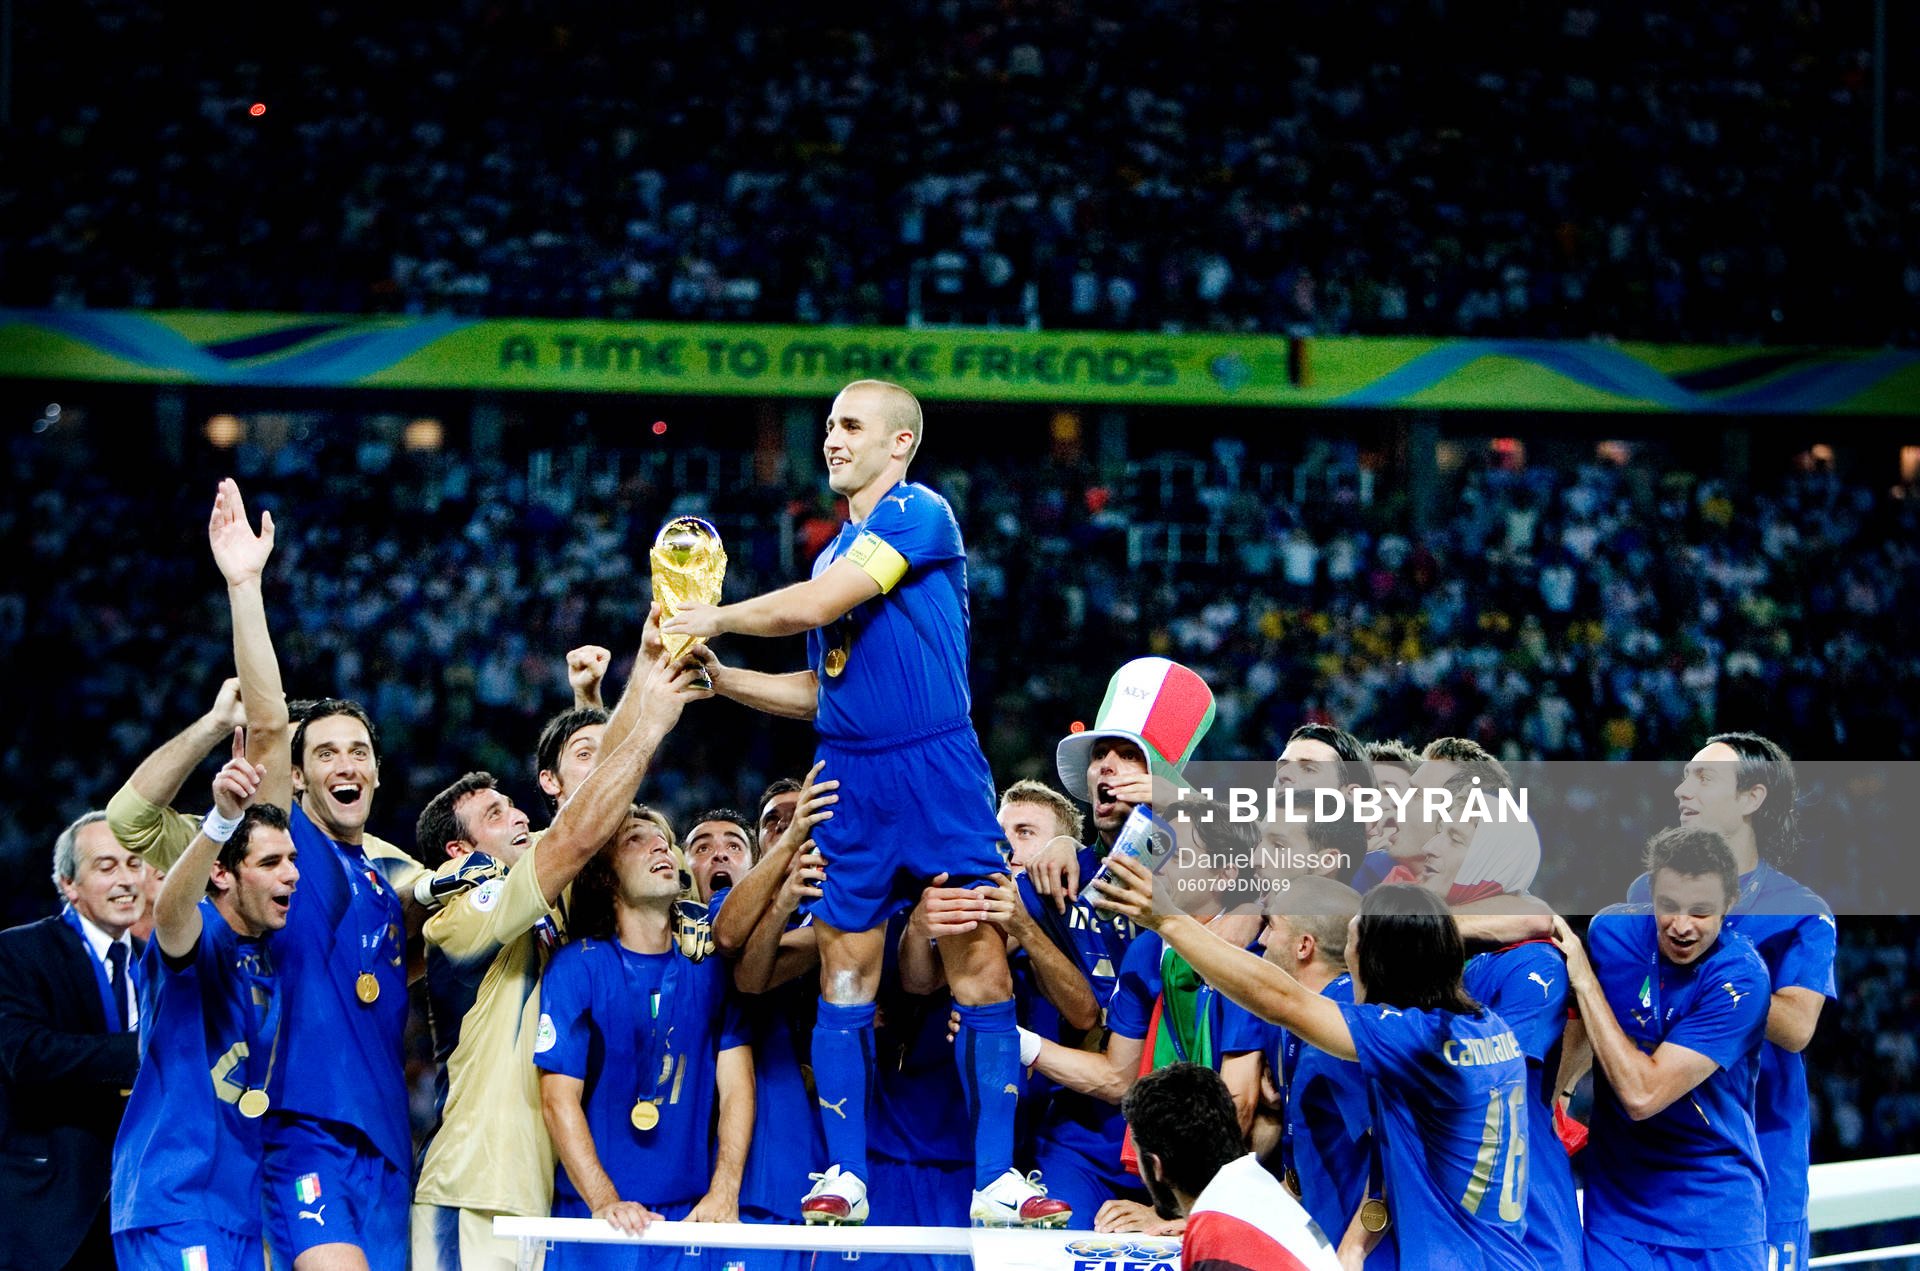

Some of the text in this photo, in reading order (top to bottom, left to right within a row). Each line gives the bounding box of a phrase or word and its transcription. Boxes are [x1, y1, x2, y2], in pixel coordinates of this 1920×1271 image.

[500, 335, 1178, 386] A TIME TO MAKE FRIENDS
[1288, 1043, 1296, 1057] FIFA
[1461, 1086, 1528, 1223] 16
